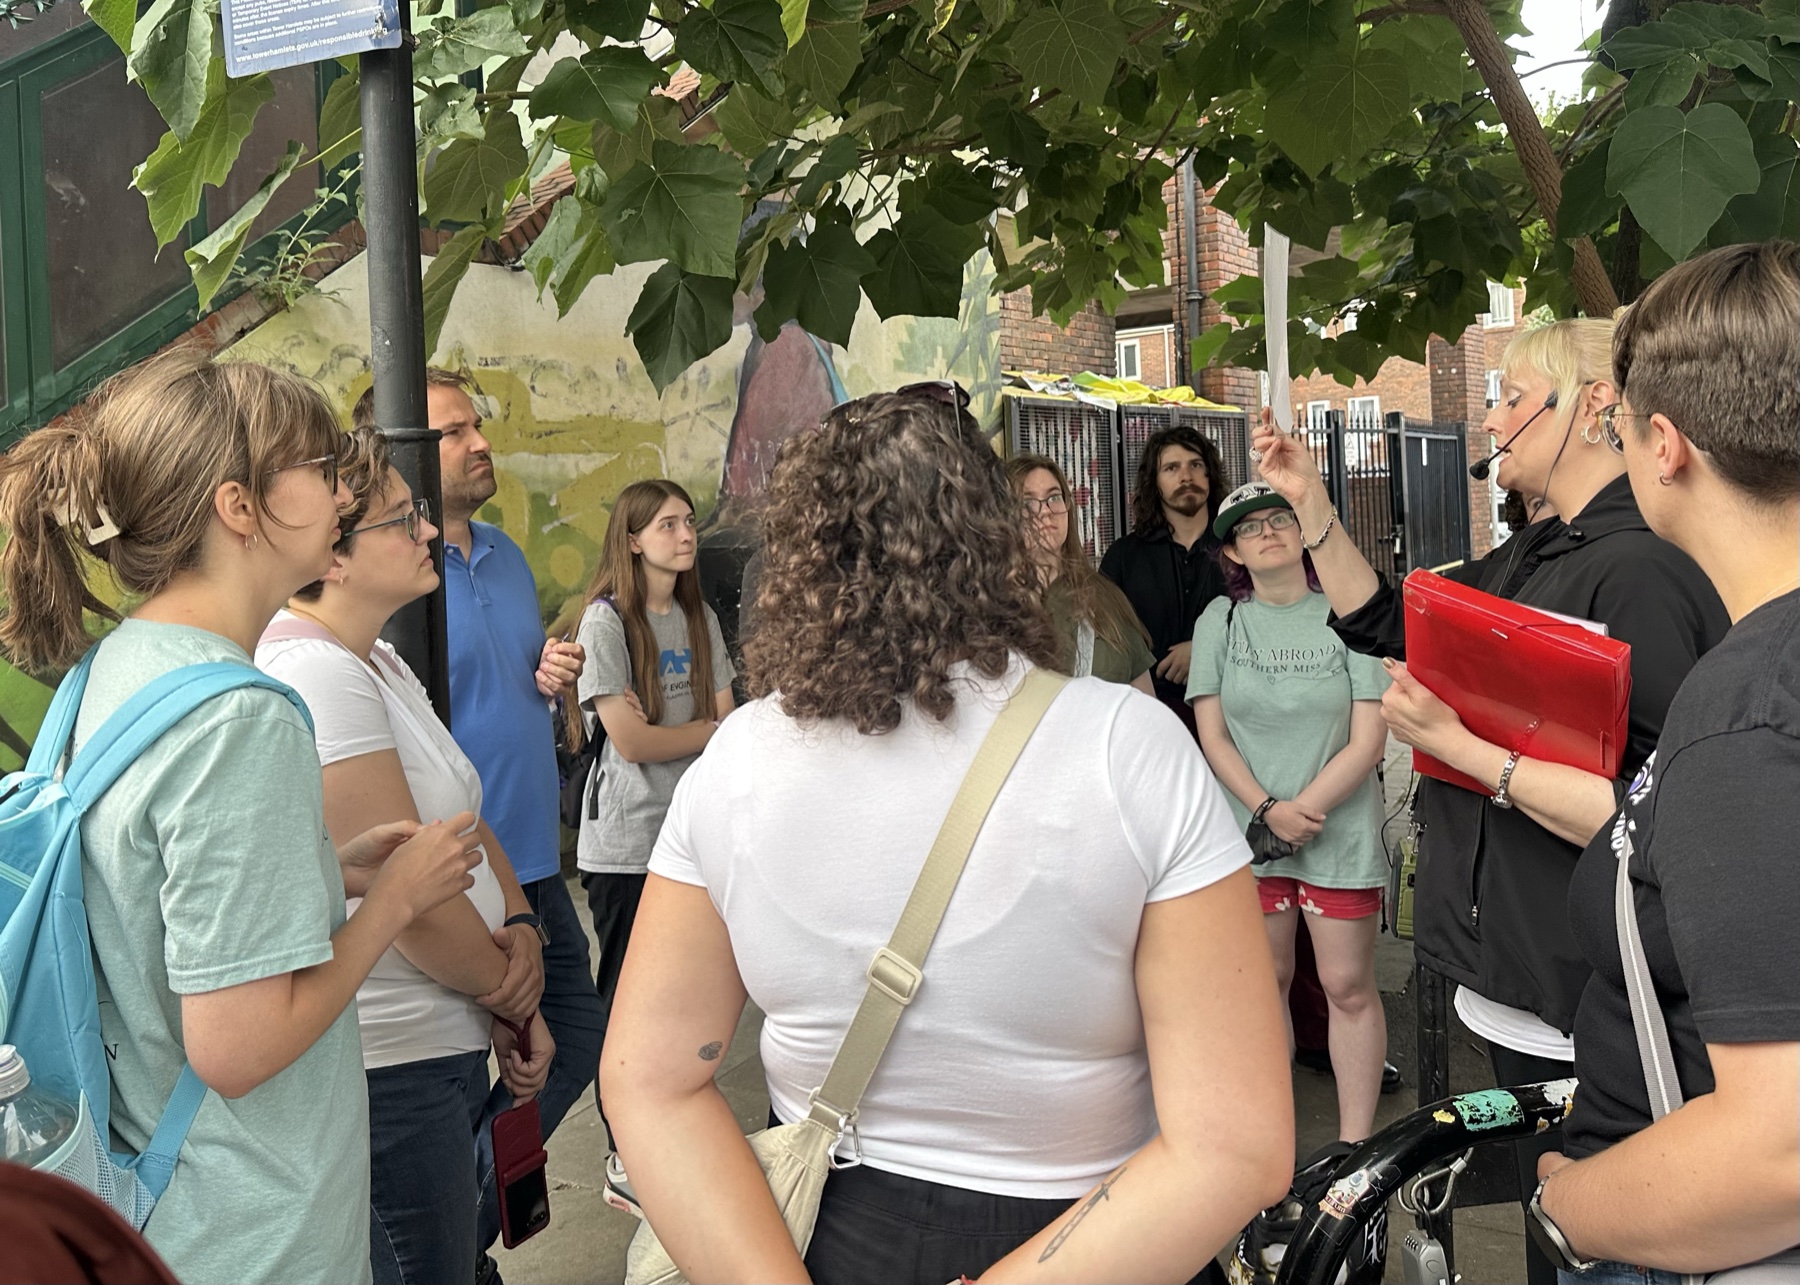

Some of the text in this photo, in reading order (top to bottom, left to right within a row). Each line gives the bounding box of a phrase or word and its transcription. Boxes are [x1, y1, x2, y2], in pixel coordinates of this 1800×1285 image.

[237, 8, 260, 16] Temporary
[285, 21, 303, 29] Hamlets
[1267, 644, 1337, 661] ABROAD
[1230, 655, 1321, 675] SOUTHERN MISS
